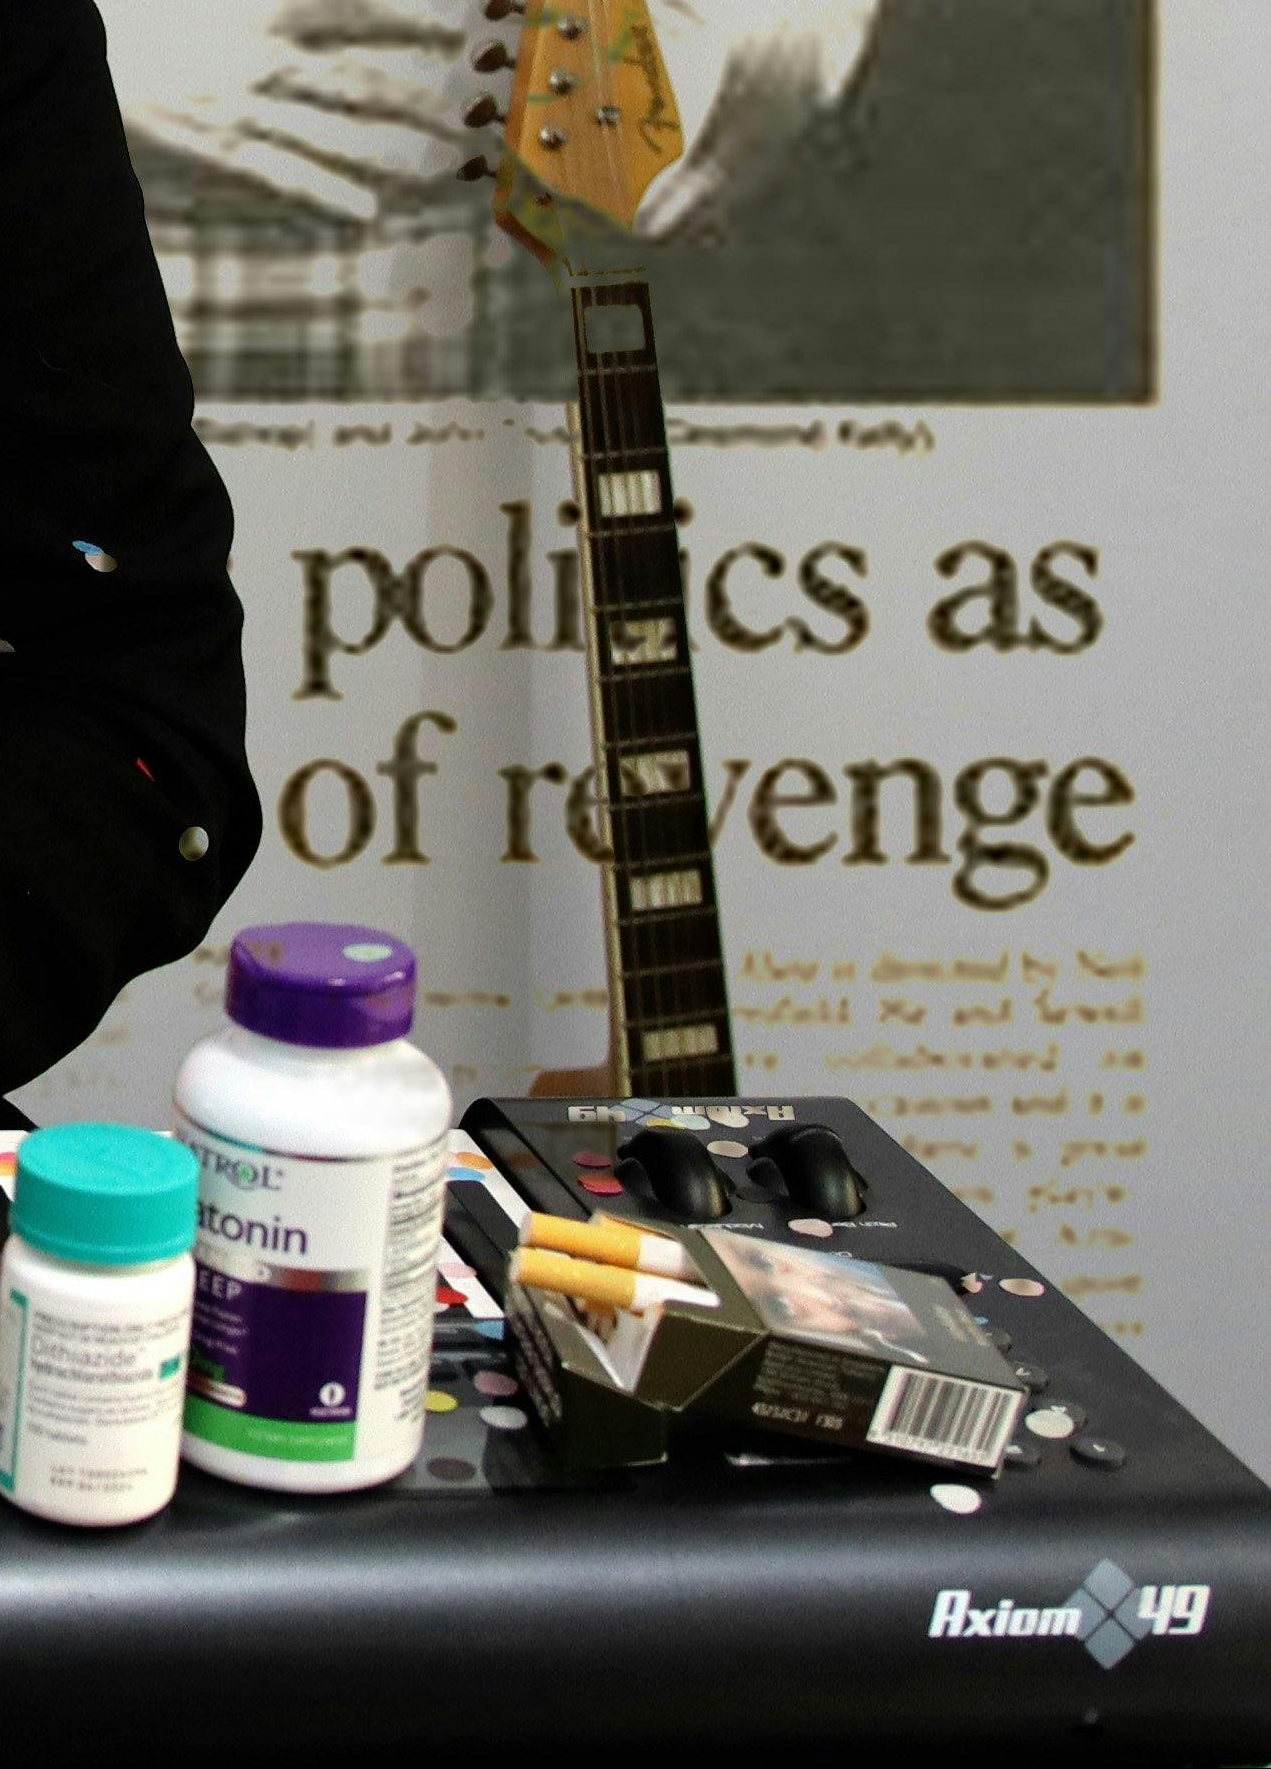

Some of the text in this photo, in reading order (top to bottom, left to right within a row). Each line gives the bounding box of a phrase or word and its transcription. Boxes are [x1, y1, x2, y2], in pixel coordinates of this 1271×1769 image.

[927, 539, 1104, 655] as
[277, 710, 458, 868] of
[194, 1146, 281, 1191] TROL
[198, 1200, 307, 1255] atonin
[198, 1271, 243, 1300] EEP
[928, 1585, 1210, 1637] Axiom 49
